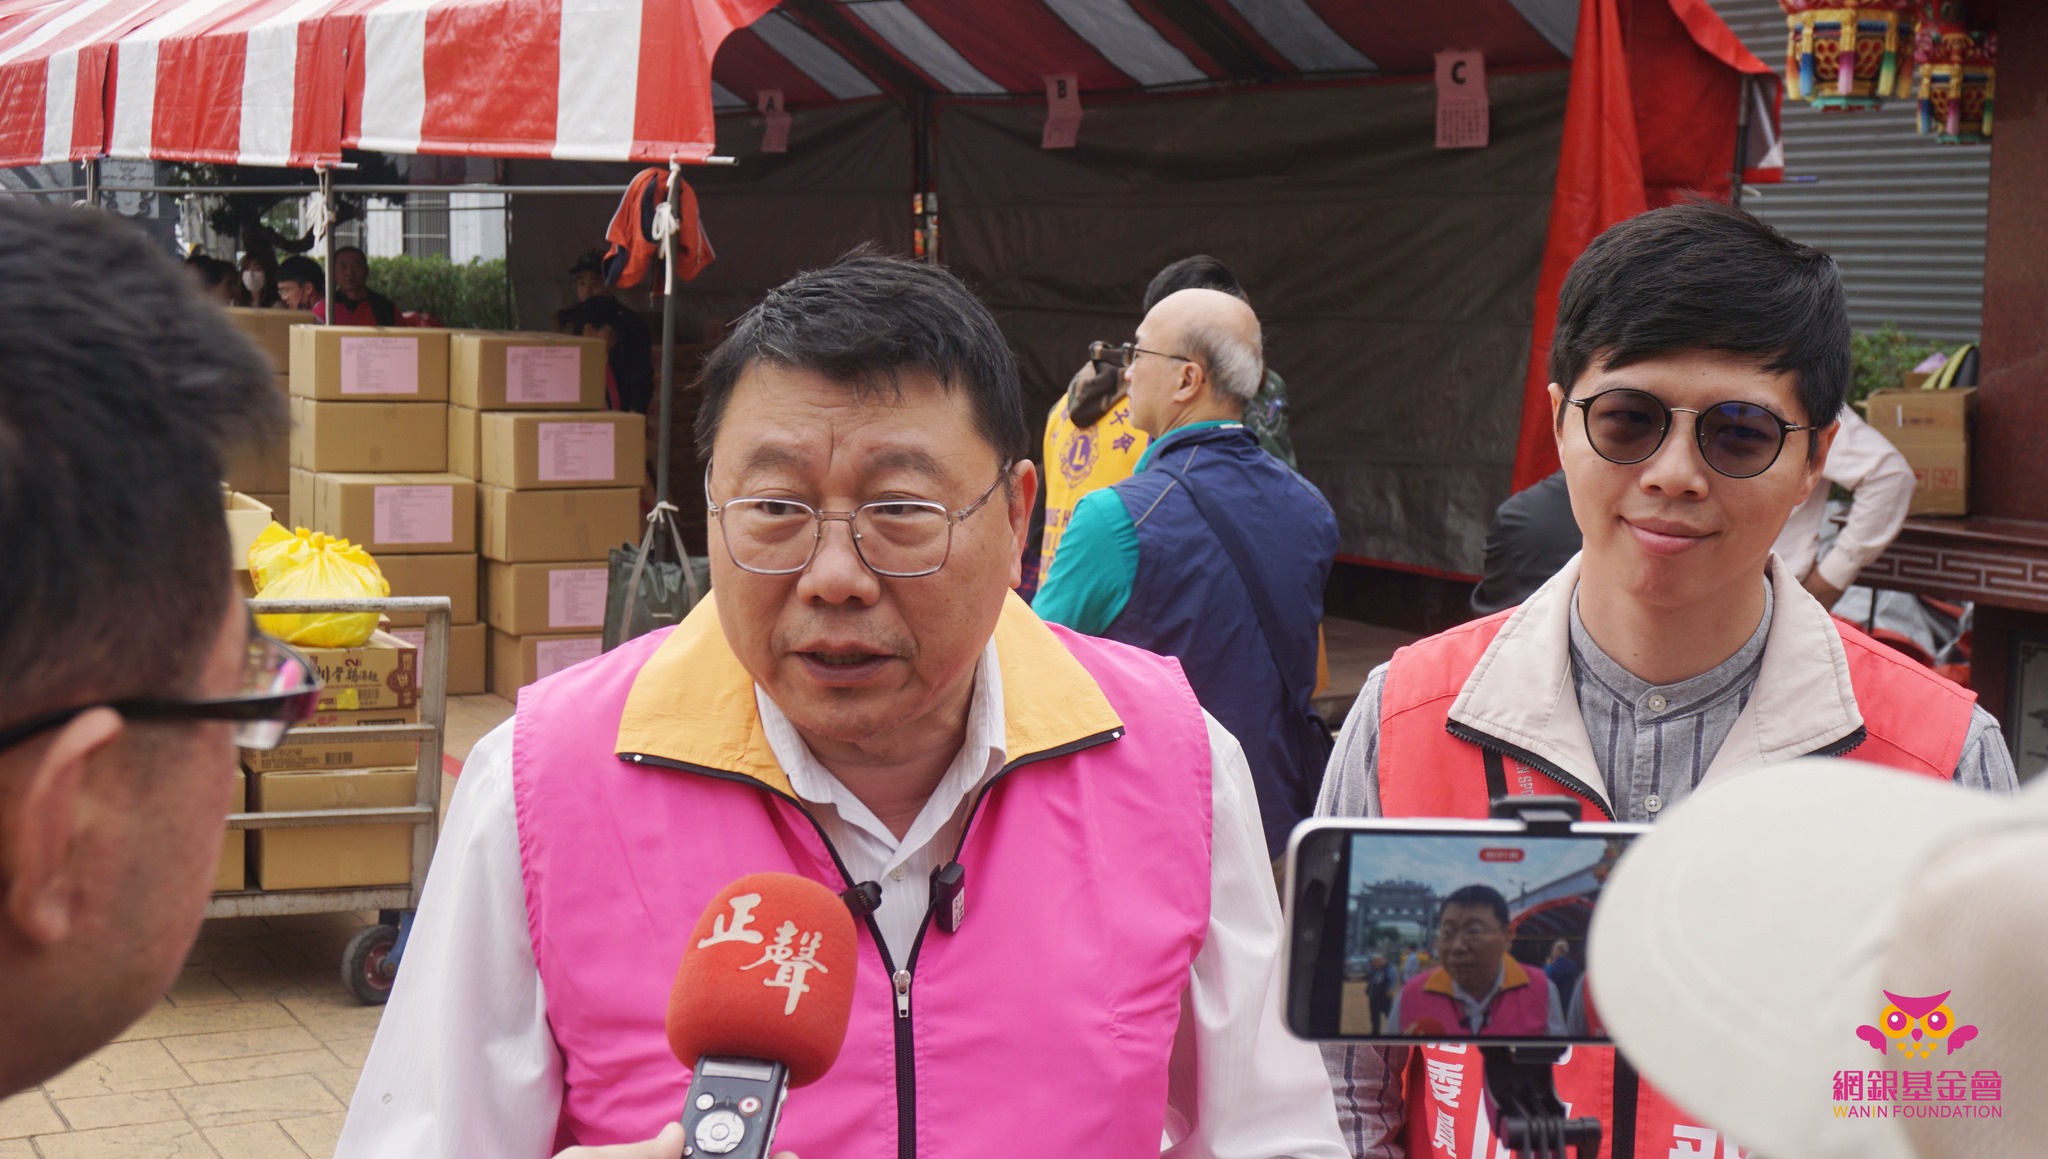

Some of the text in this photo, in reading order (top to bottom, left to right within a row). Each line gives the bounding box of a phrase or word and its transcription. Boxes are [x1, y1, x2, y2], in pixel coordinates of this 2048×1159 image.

[1451, 60, 1467, 84] C
[1056, 79, 1067, 98] B
[766, 96, 776, 112] A
[697, 893, 829, 1016] 正聲
